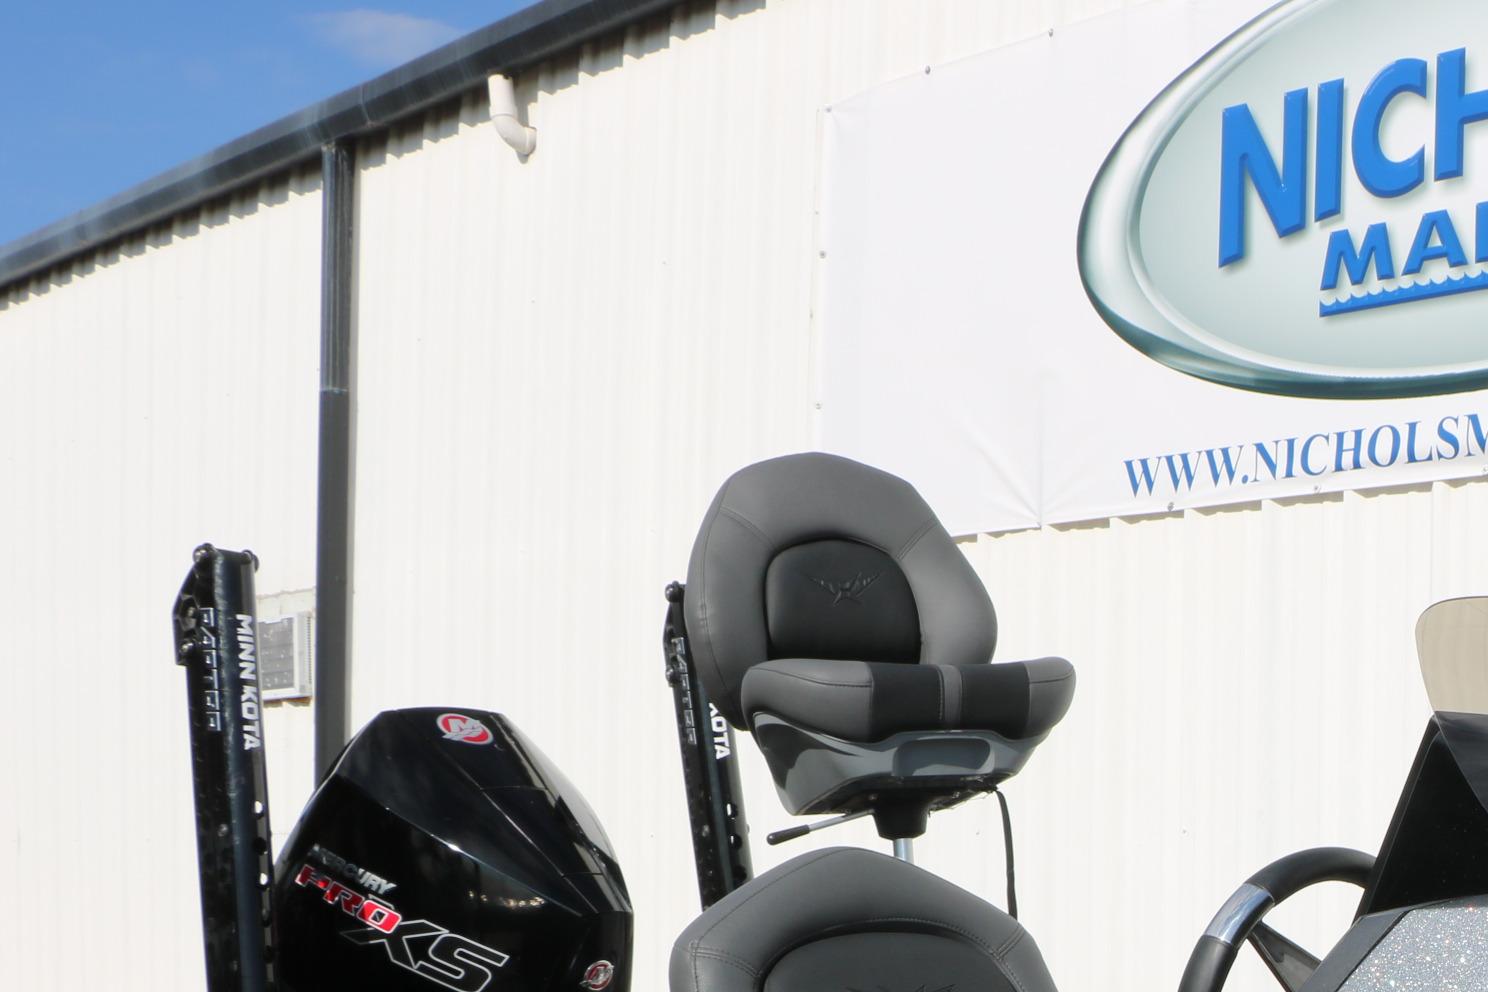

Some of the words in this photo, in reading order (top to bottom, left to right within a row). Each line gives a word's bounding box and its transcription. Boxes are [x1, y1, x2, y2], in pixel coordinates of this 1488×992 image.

[235, 613, 257, 681] MINN
[240, 684, 262, 751] KOTA
[294, 863, 402, 934] PRO
